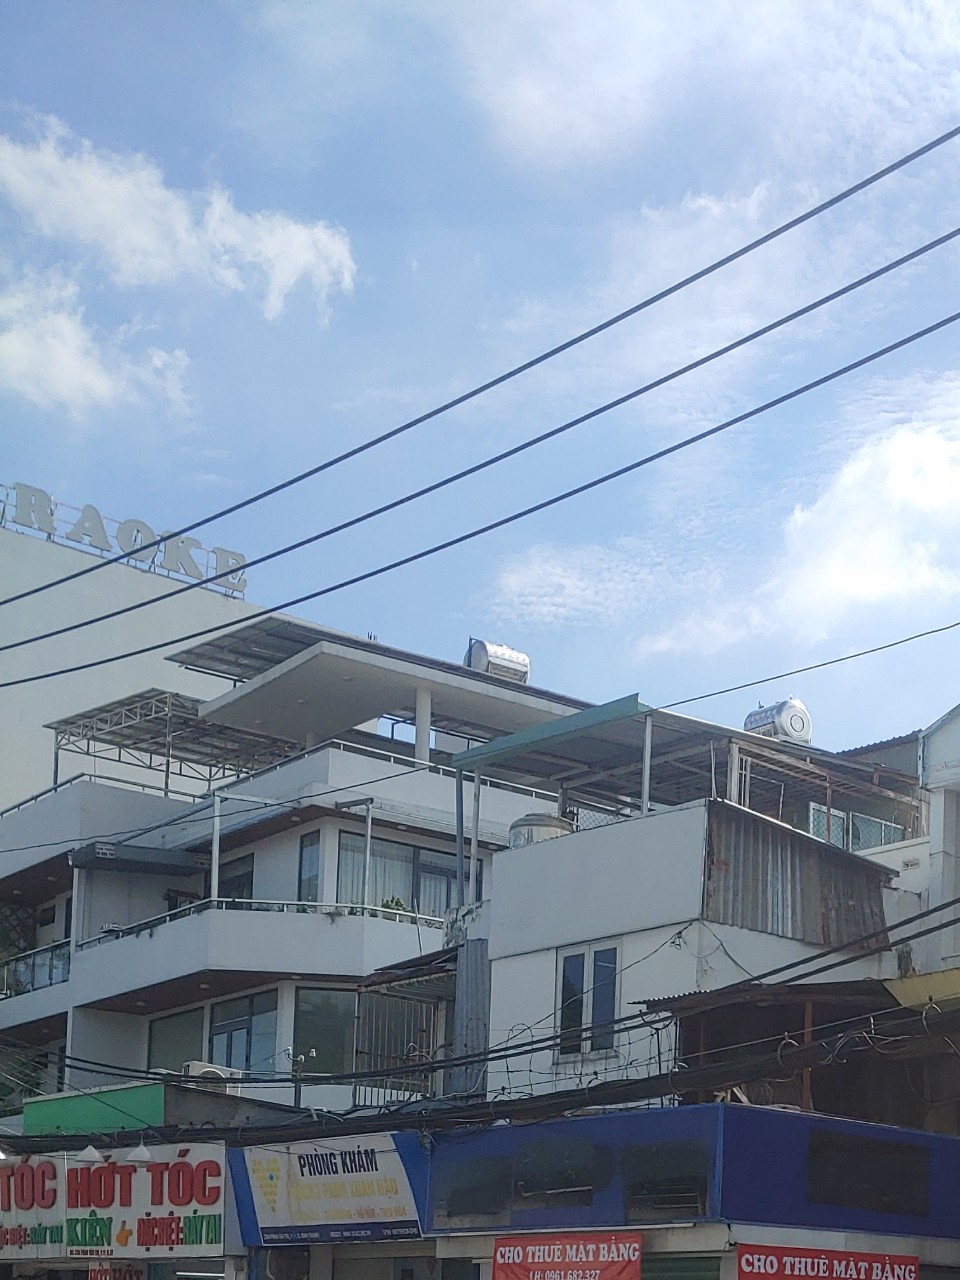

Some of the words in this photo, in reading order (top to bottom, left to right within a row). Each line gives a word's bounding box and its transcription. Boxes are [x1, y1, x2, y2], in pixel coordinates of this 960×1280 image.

[67, 1154, 137, 1208] HỚT
[146, 1148, 221, 1206] TÓC
[297, 1148, 339, 1177] PHÒNG
[340, 1145, 379, 1174] KHÁM
[0, 1153, 57, 1212] TÓC
[66, 1209, 114, 1247] KIÊN
[496, 1246, 523, 1264] CHO
[526, 1241, 562, 1263] THUÊ
[565, 1240, 597, 1265] MẶT
[599, 1236, 640, 1262] BẰNG
[741, 1253, 779, 1275] CHO
[782, 1255, 829, 1278] THUÊ
[832, 1256, 869, 1280] MẶT
